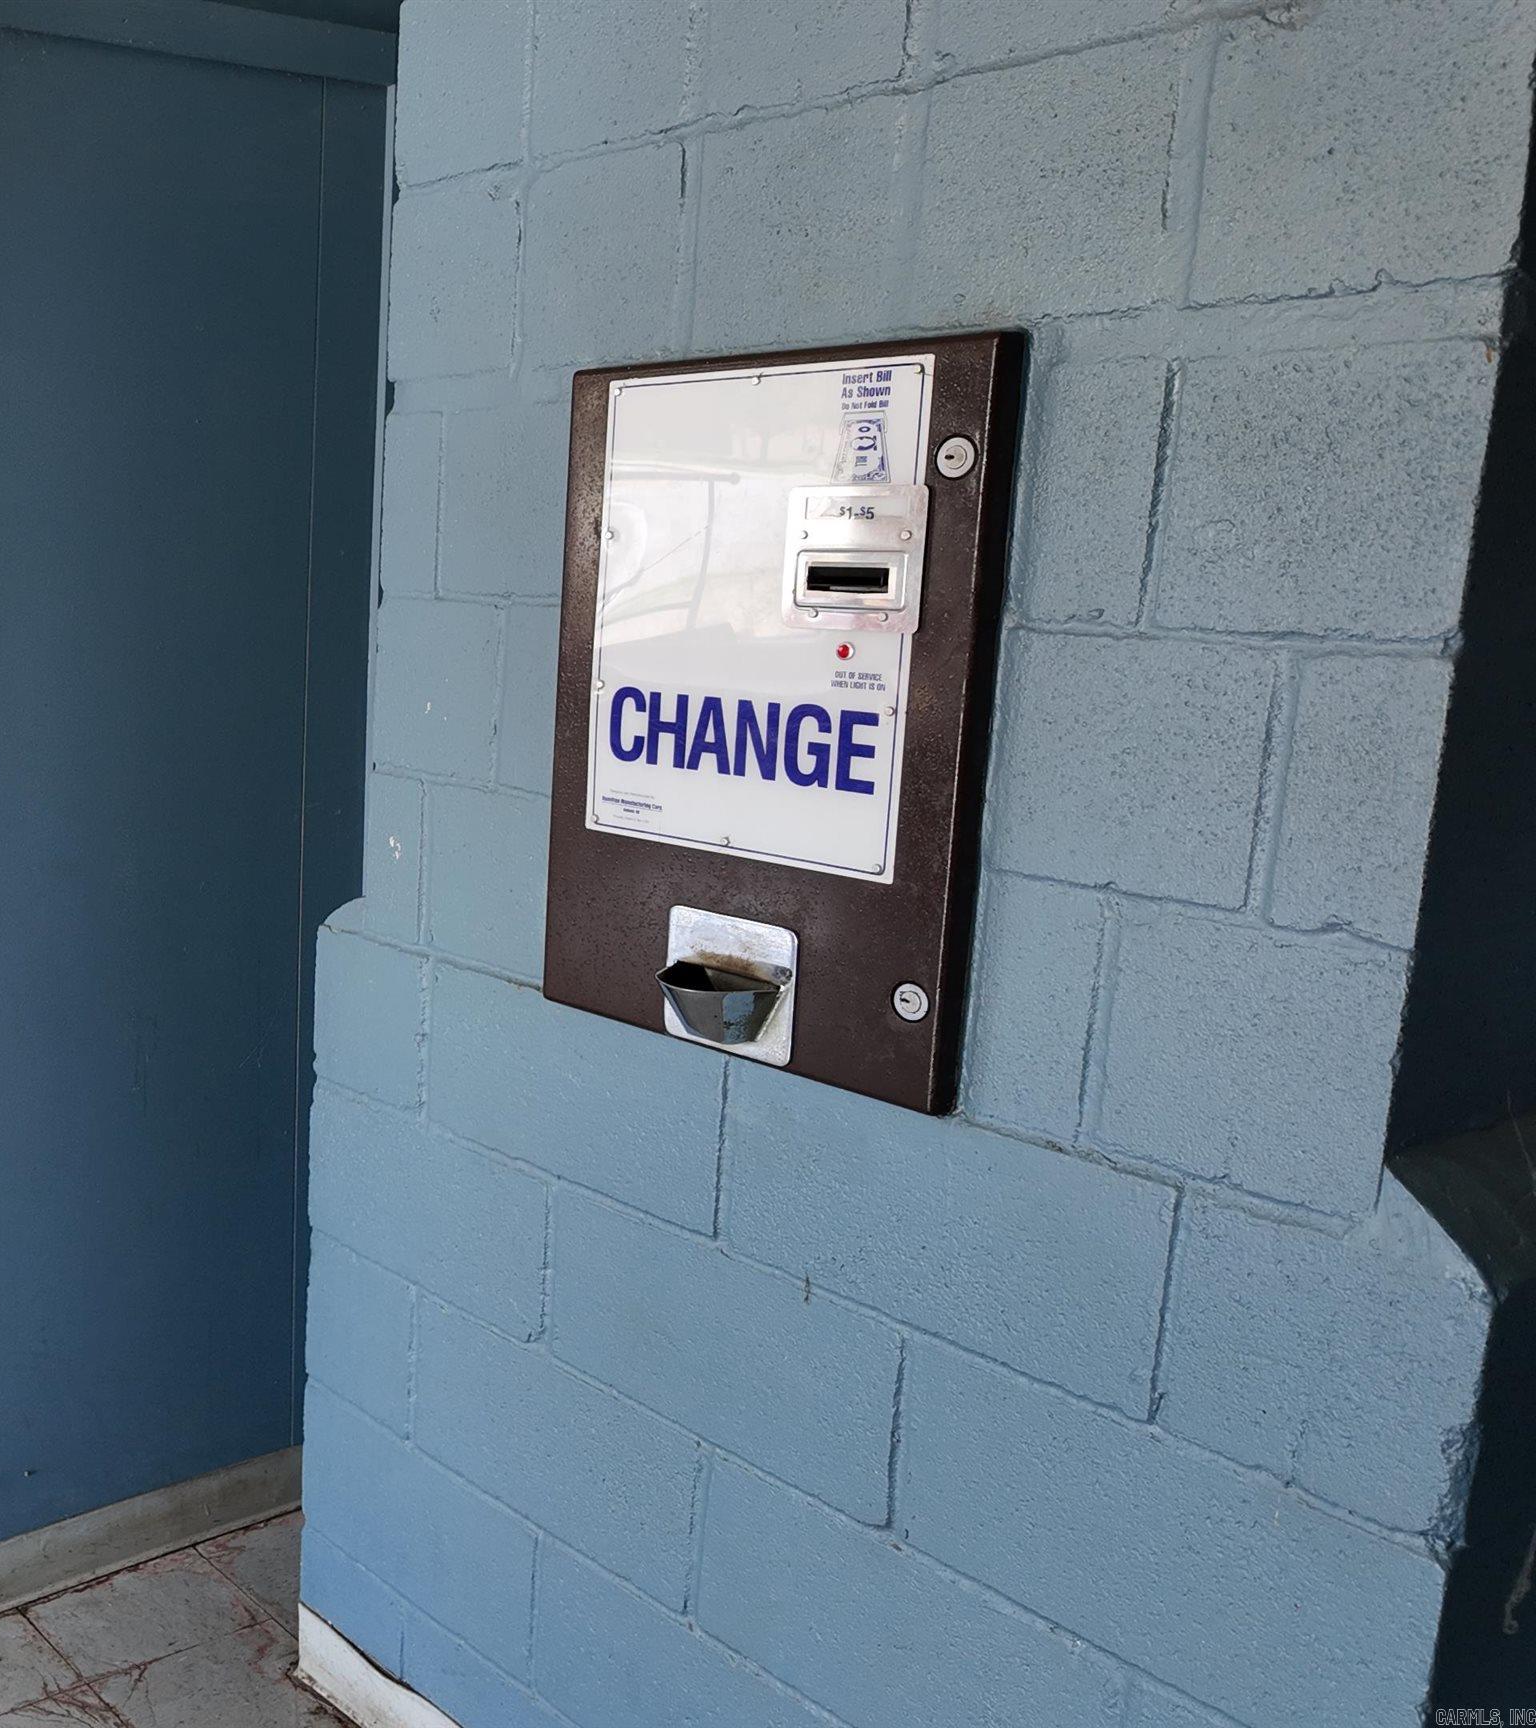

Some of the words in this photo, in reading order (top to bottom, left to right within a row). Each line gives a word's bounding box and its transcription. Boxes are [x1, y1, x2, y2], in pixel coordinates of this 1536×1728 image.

[842, 372, 873, 385] Insert
[876, 370, 892, 382] Bill
[841, 387, 853, 399] As
[857, 386, 891, 398] Shown
[864, 401, 877, 409] Fold
[879, 400, 889, 408] Bill
[839, 506, 875, 520] $1-$5
[835, 670, 846, 679] OUT
[848, 671, 855, 680] OF
[858, 672, 882, 681] SERVICE
[830, 680, 848, 688] WHEN
[850, 681, 866, 690] LIGHT
[869, 682, 875, 690] IS
[876, 683, 885, 691] ON
[609, 686, 879, 796] CHANGE
